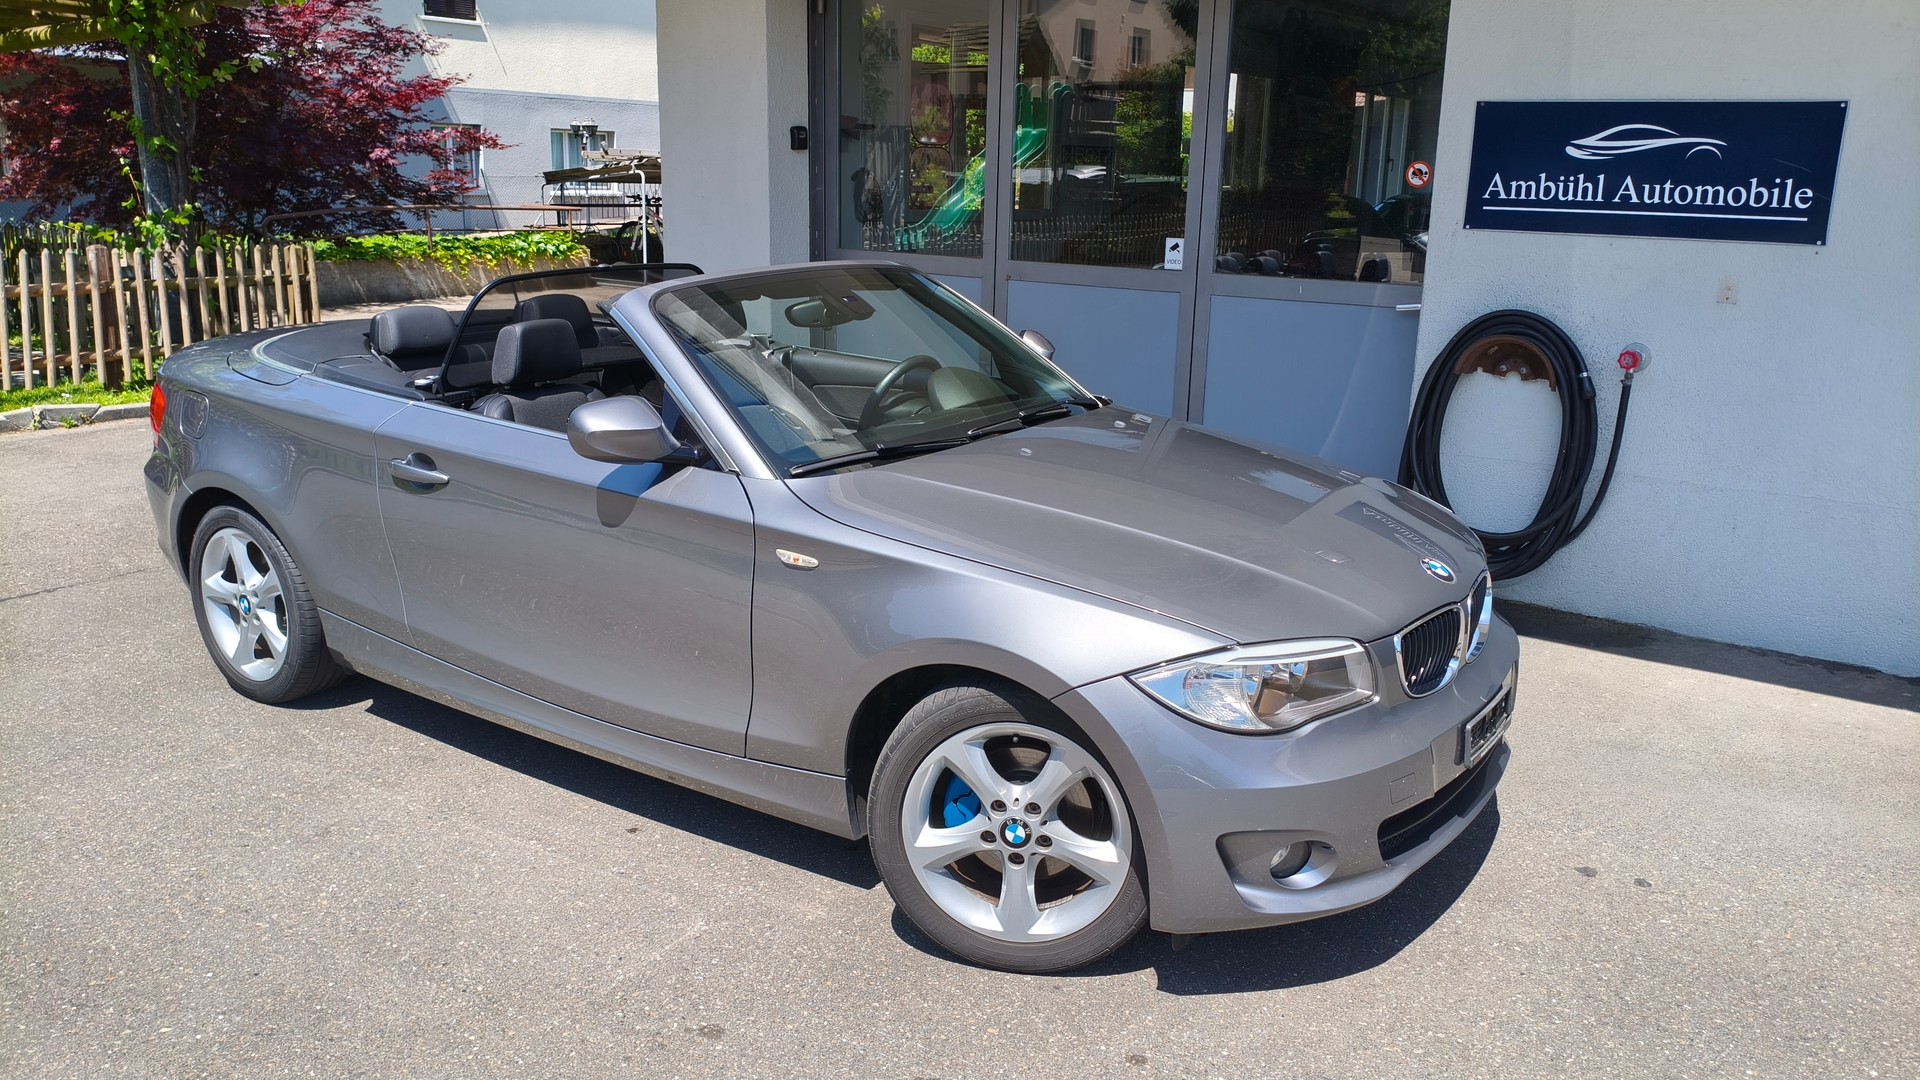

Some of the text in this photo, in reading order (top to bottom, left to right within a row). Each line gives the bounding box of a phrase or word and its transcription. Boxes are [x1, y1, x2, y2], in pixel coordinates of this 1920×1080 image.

[1482, 172, 1814, 209] Ambühl Automobile
[941, 701, 1013, 723] ContiSportCo
